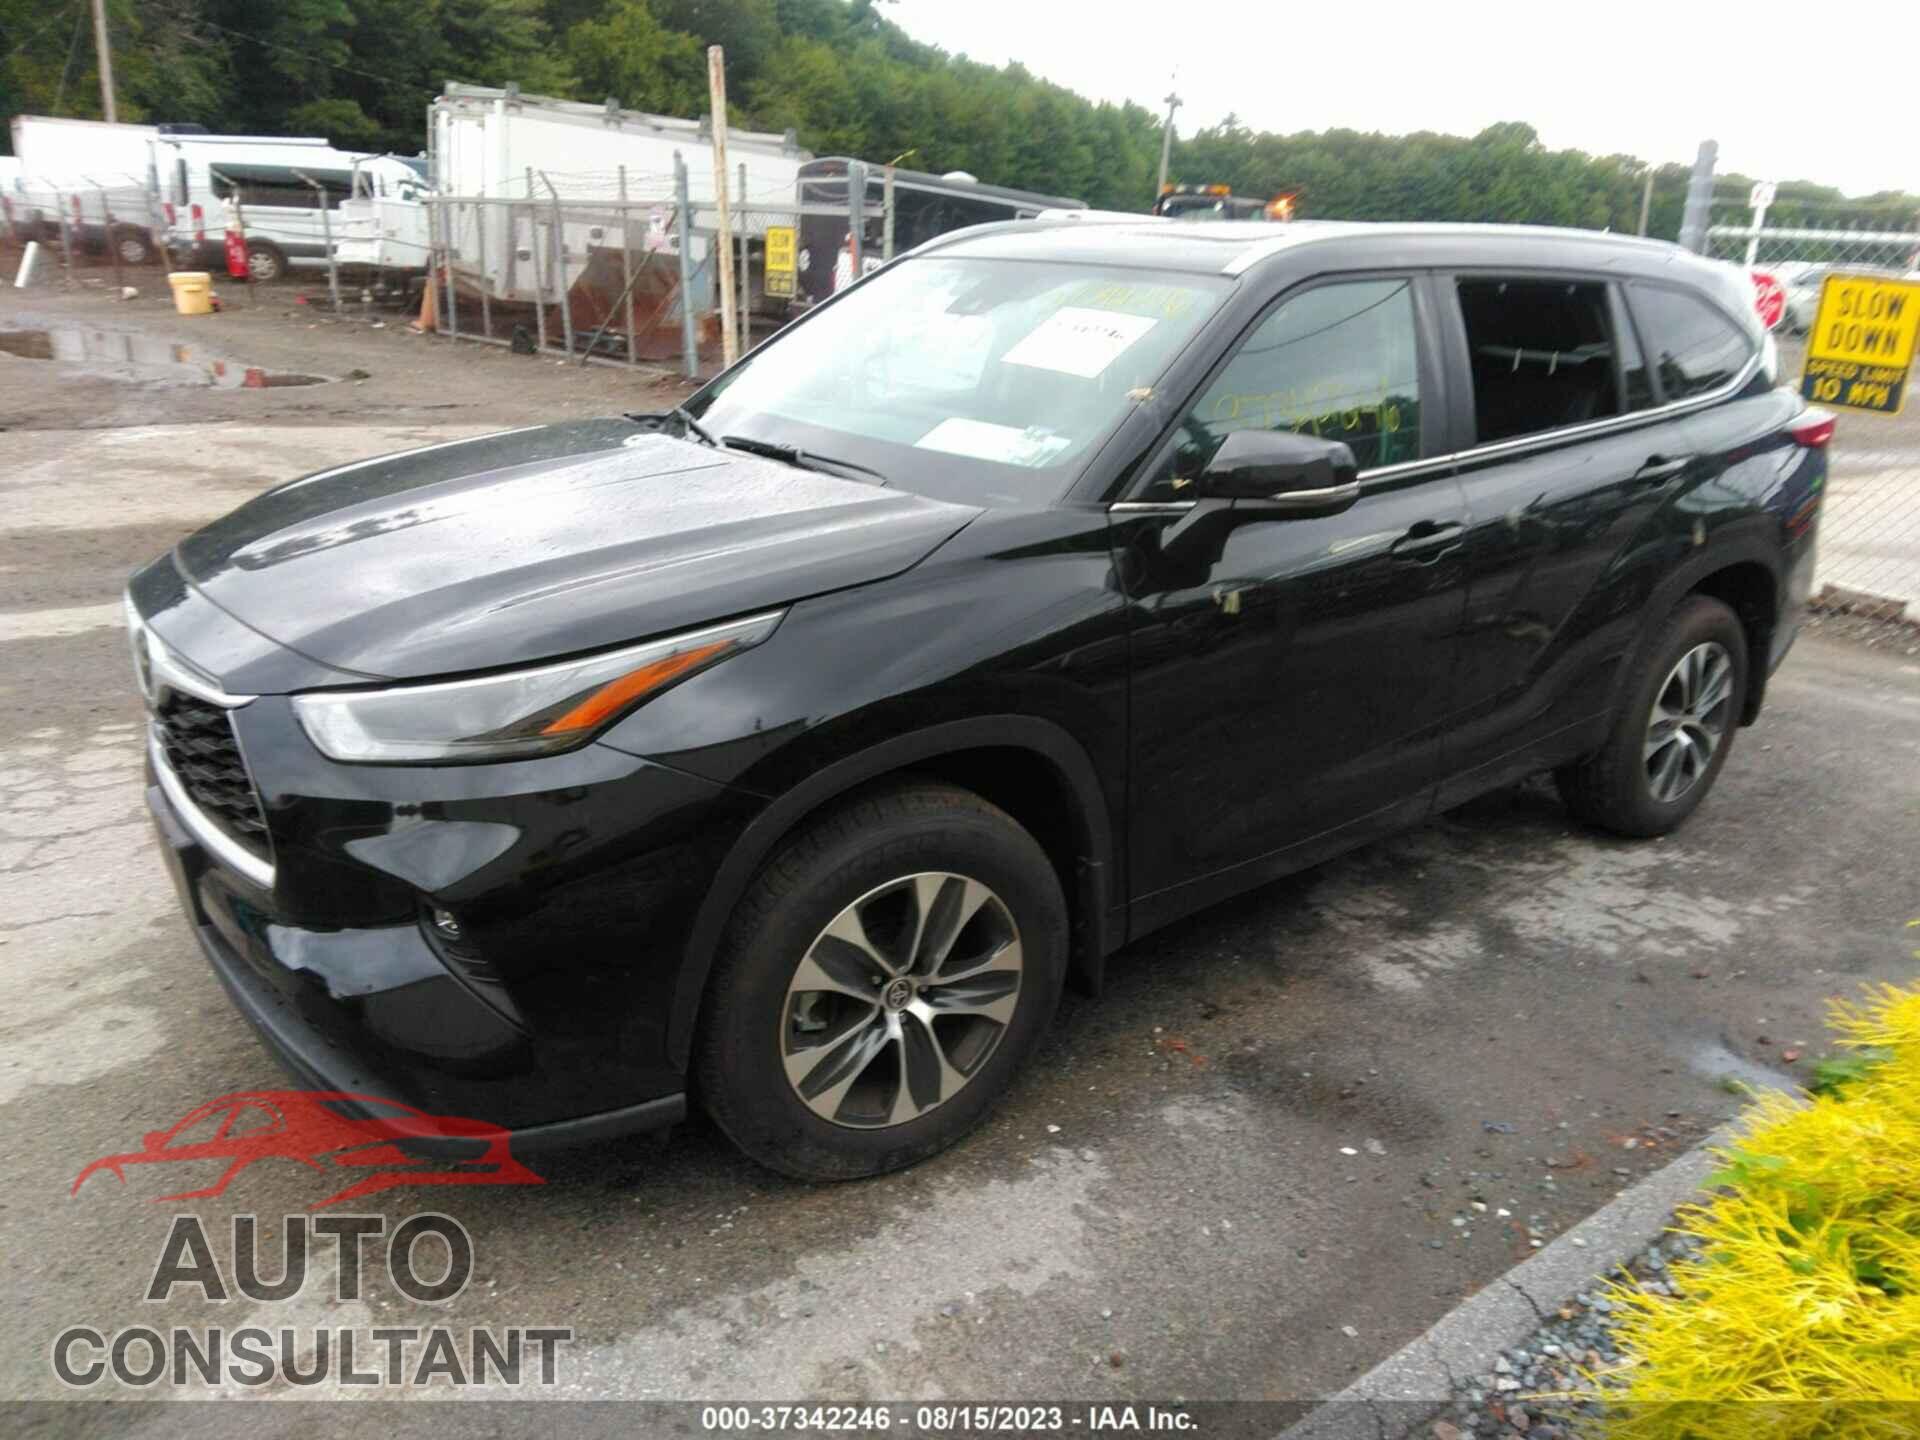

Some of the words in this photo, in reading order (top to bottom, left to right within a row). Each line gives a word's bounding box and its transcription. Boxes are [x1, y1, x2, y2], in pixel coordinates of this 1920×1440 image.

[1837, 287, 1909, 321] SLOW
[1827, 321, 1900, 356] DOWN
[1807, 359, 1858, 379] SPEED
[1812, 376, 1842, 400] 10
[1847, 381, 1891, 408] MPH
